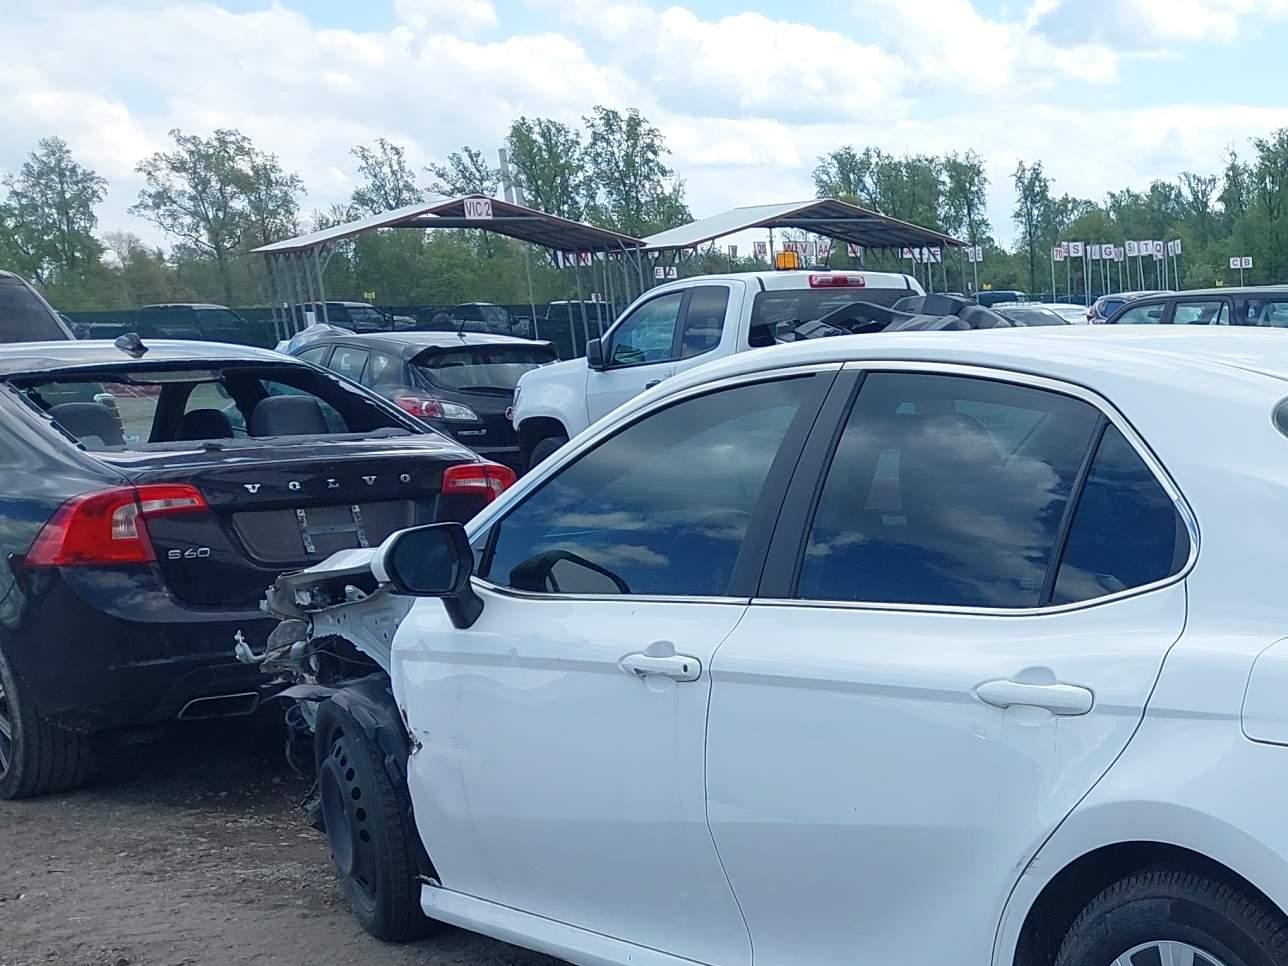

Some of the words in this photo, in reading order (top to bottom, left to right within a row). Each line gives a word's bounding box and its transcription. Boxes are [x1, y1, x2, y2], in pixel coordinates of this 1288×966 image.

[465, 201, 483, 217] VIC
[484, 201, 491, 217] 2
[1072, 244, 1080, 254] S
[1104, 246, 1113, 257] G
[243, 473, 411, 494] VOLVO
[167, 547, 210, 560] S60
